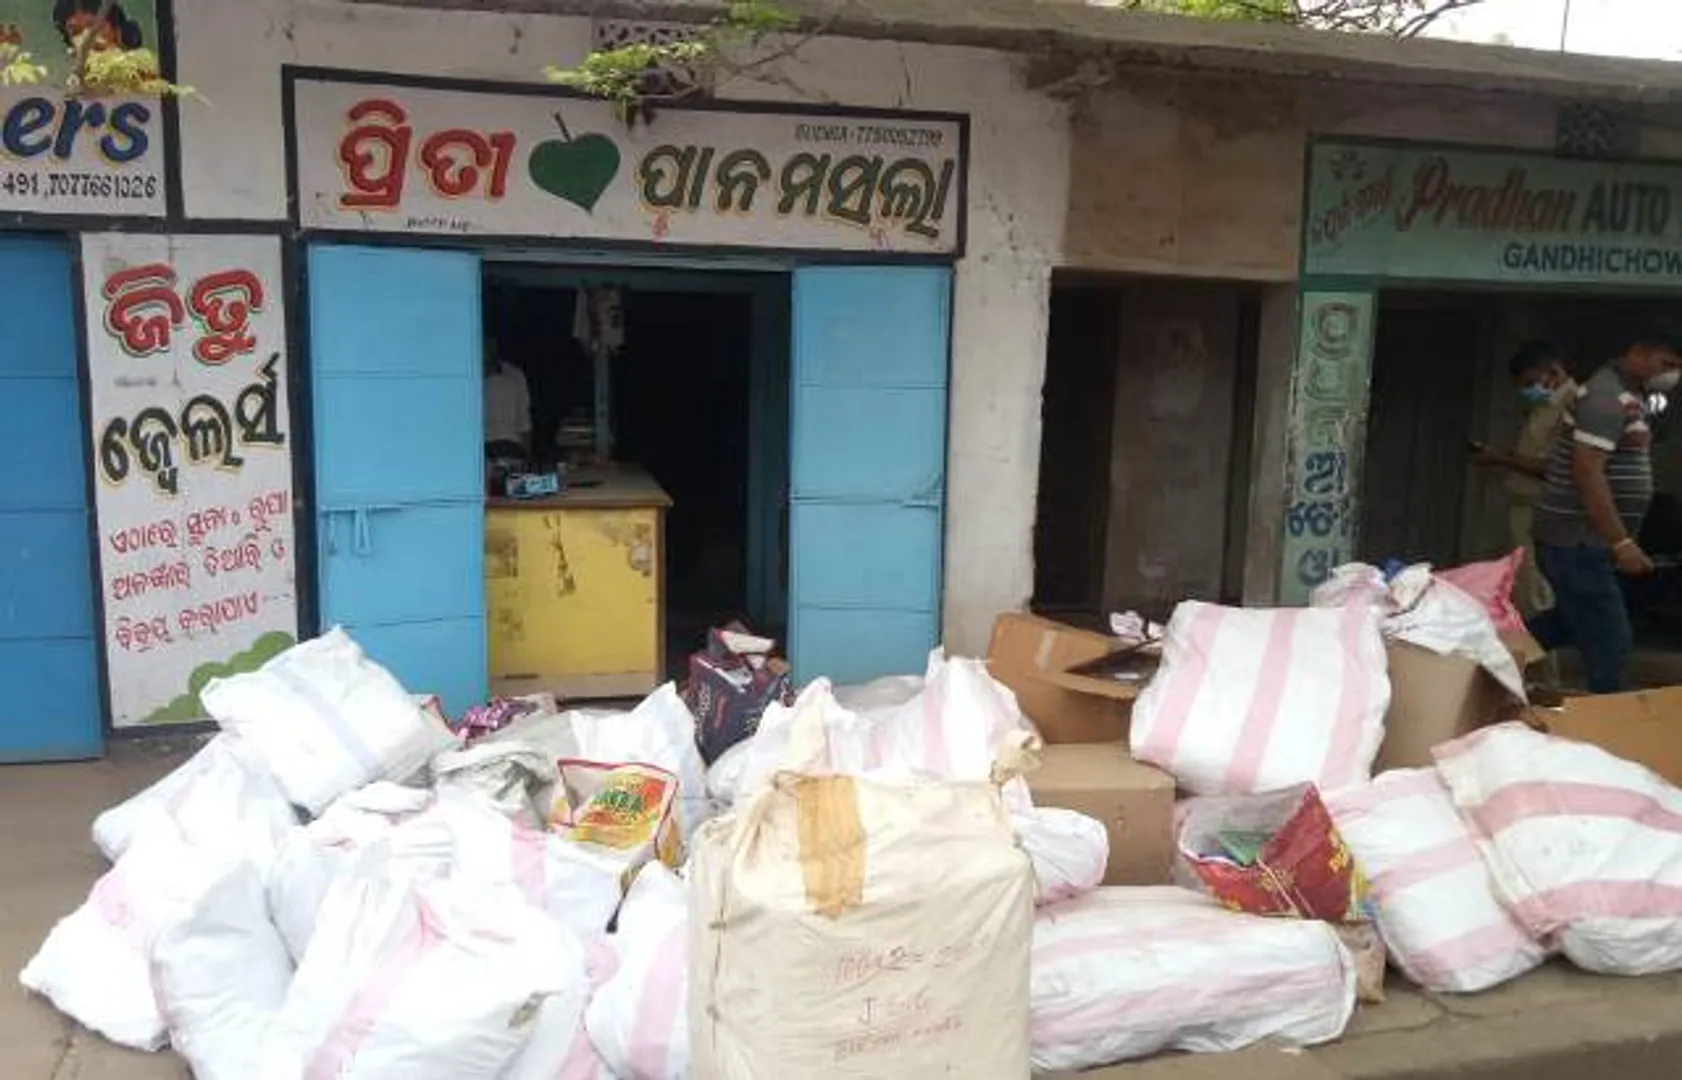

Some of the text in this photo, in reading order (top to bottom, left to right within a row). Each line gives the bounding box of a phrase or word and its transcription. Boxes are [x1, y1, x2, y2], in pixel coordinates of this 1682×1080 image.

[2, 97, 150, 162] ers
[1581, 181, 1671, 235] AUTO
[104, 263, 264, 365] ଜିତୁ
